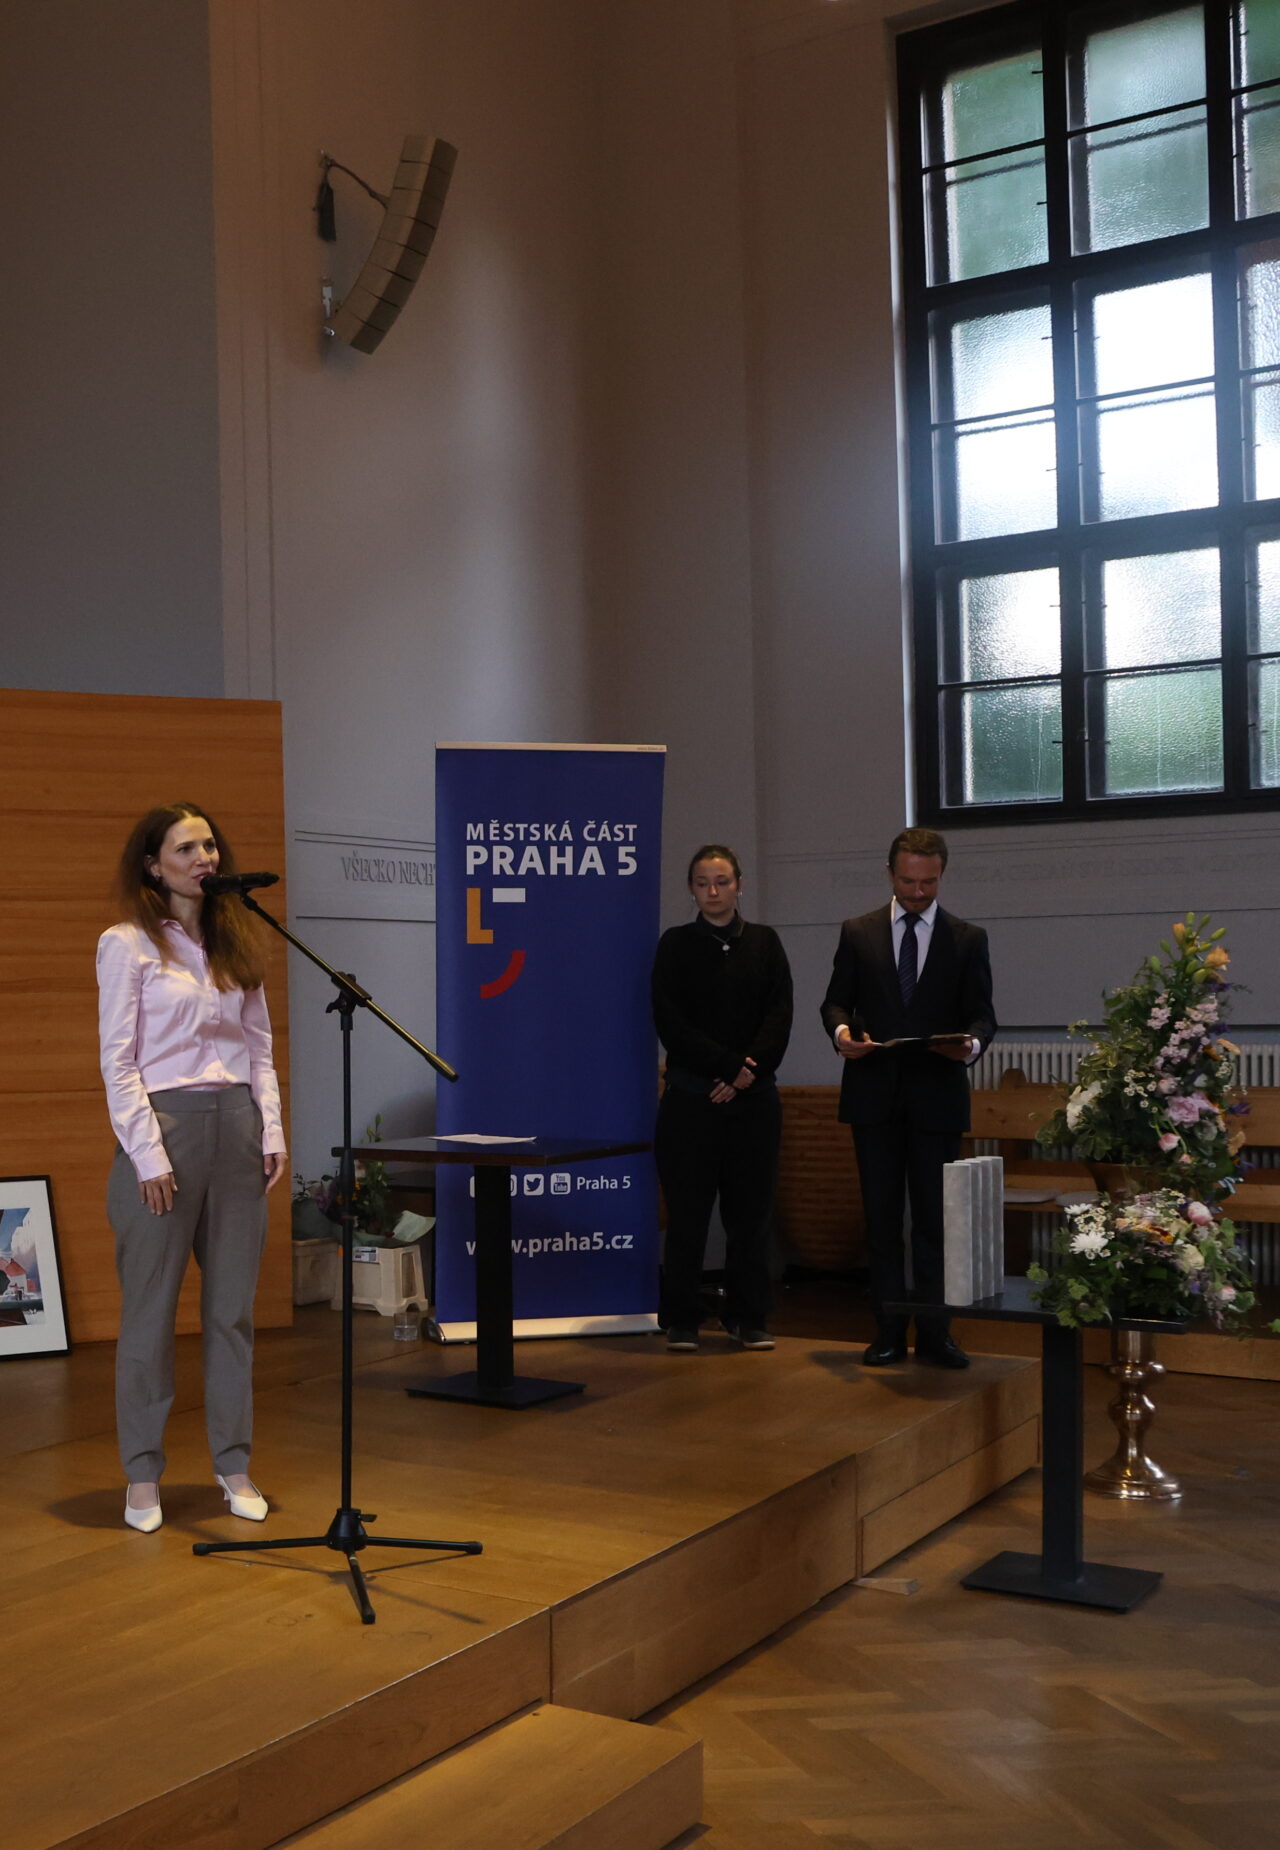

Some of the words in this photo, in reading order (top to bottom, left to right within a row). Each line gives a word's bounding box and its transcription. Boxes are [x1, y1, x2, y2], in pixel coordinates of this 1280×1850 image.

[466, 819, 573, 841] MĚSTSKÁ
[583, 820, 638, 842] ČÁST
[340, 850, 396, 883] VŠECKO
[399, 860, 436, 886] NECH
[466, 845, 606, 876] PRAHA
[617, 846, 638, 876] 5
[576, 1175, 618, 1190] Praha
[621, 1175, 631, 1189] 5
